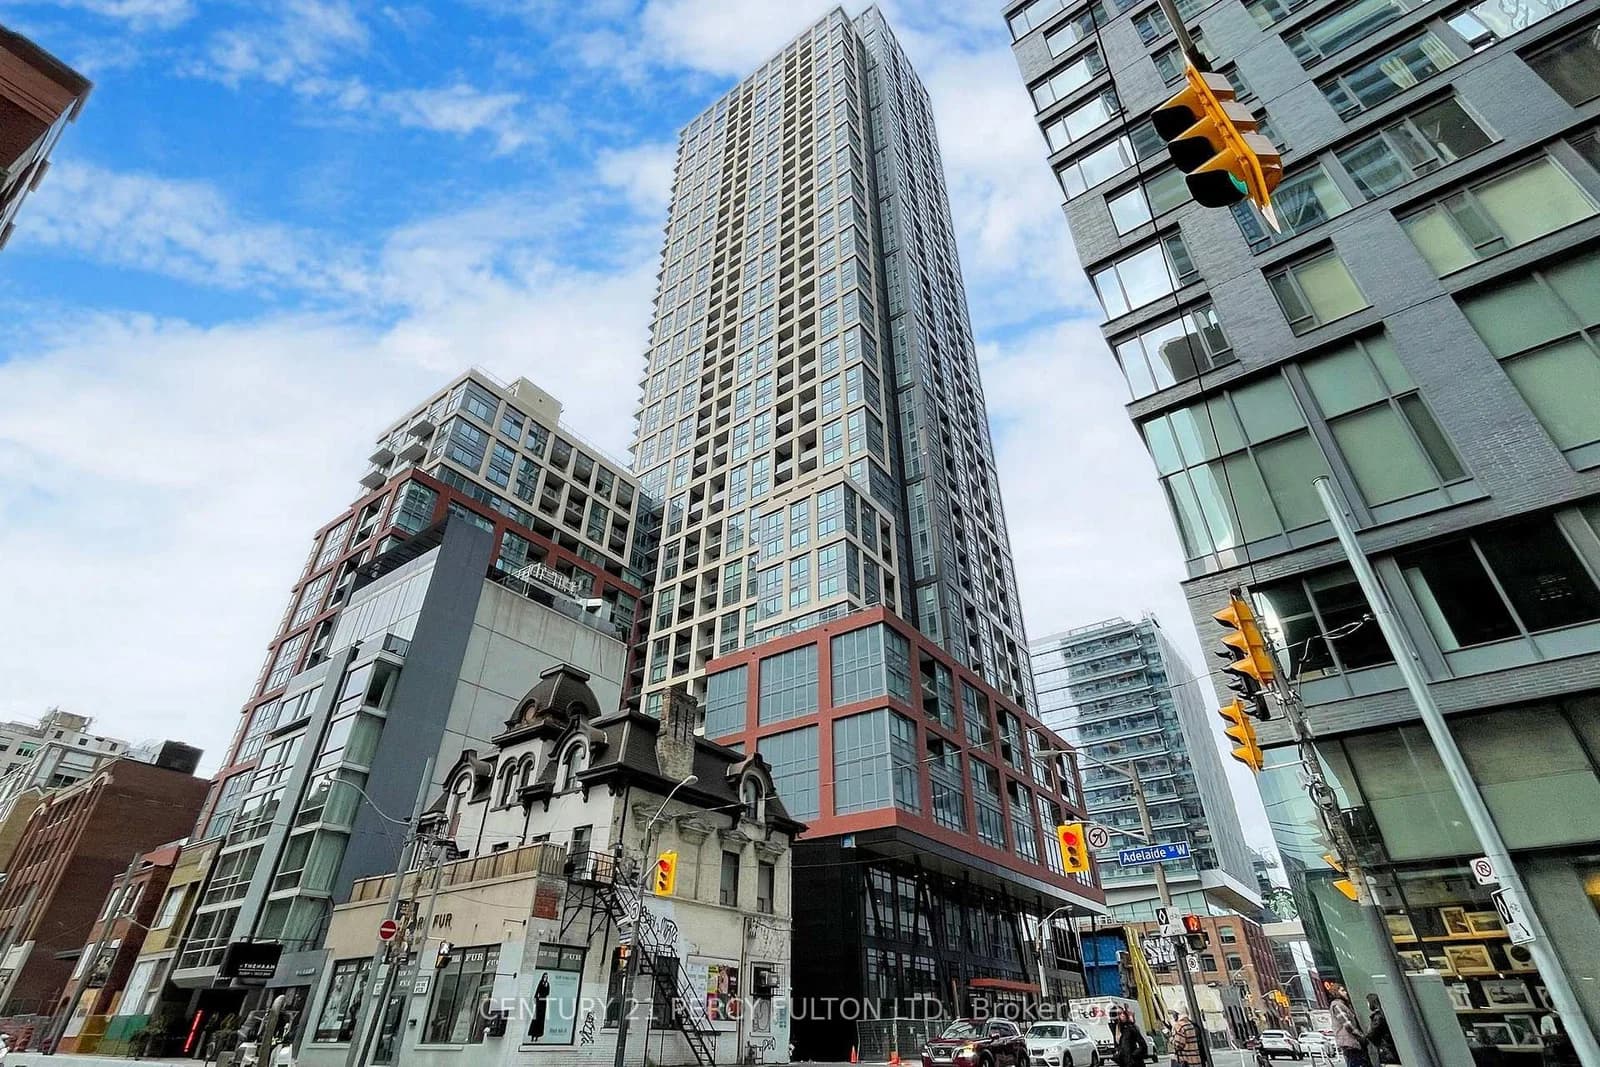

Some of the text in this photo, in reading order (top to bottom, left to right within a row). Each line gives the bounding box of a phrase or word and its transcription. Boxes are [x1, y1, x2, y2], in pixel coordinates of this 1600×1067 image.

[1122, 848, 1167, 863] Adelaide
[1175, 844, 1186, 855] W
[432, 912, 453, 929] FUR
[464, 952, 484, 962] FUR
